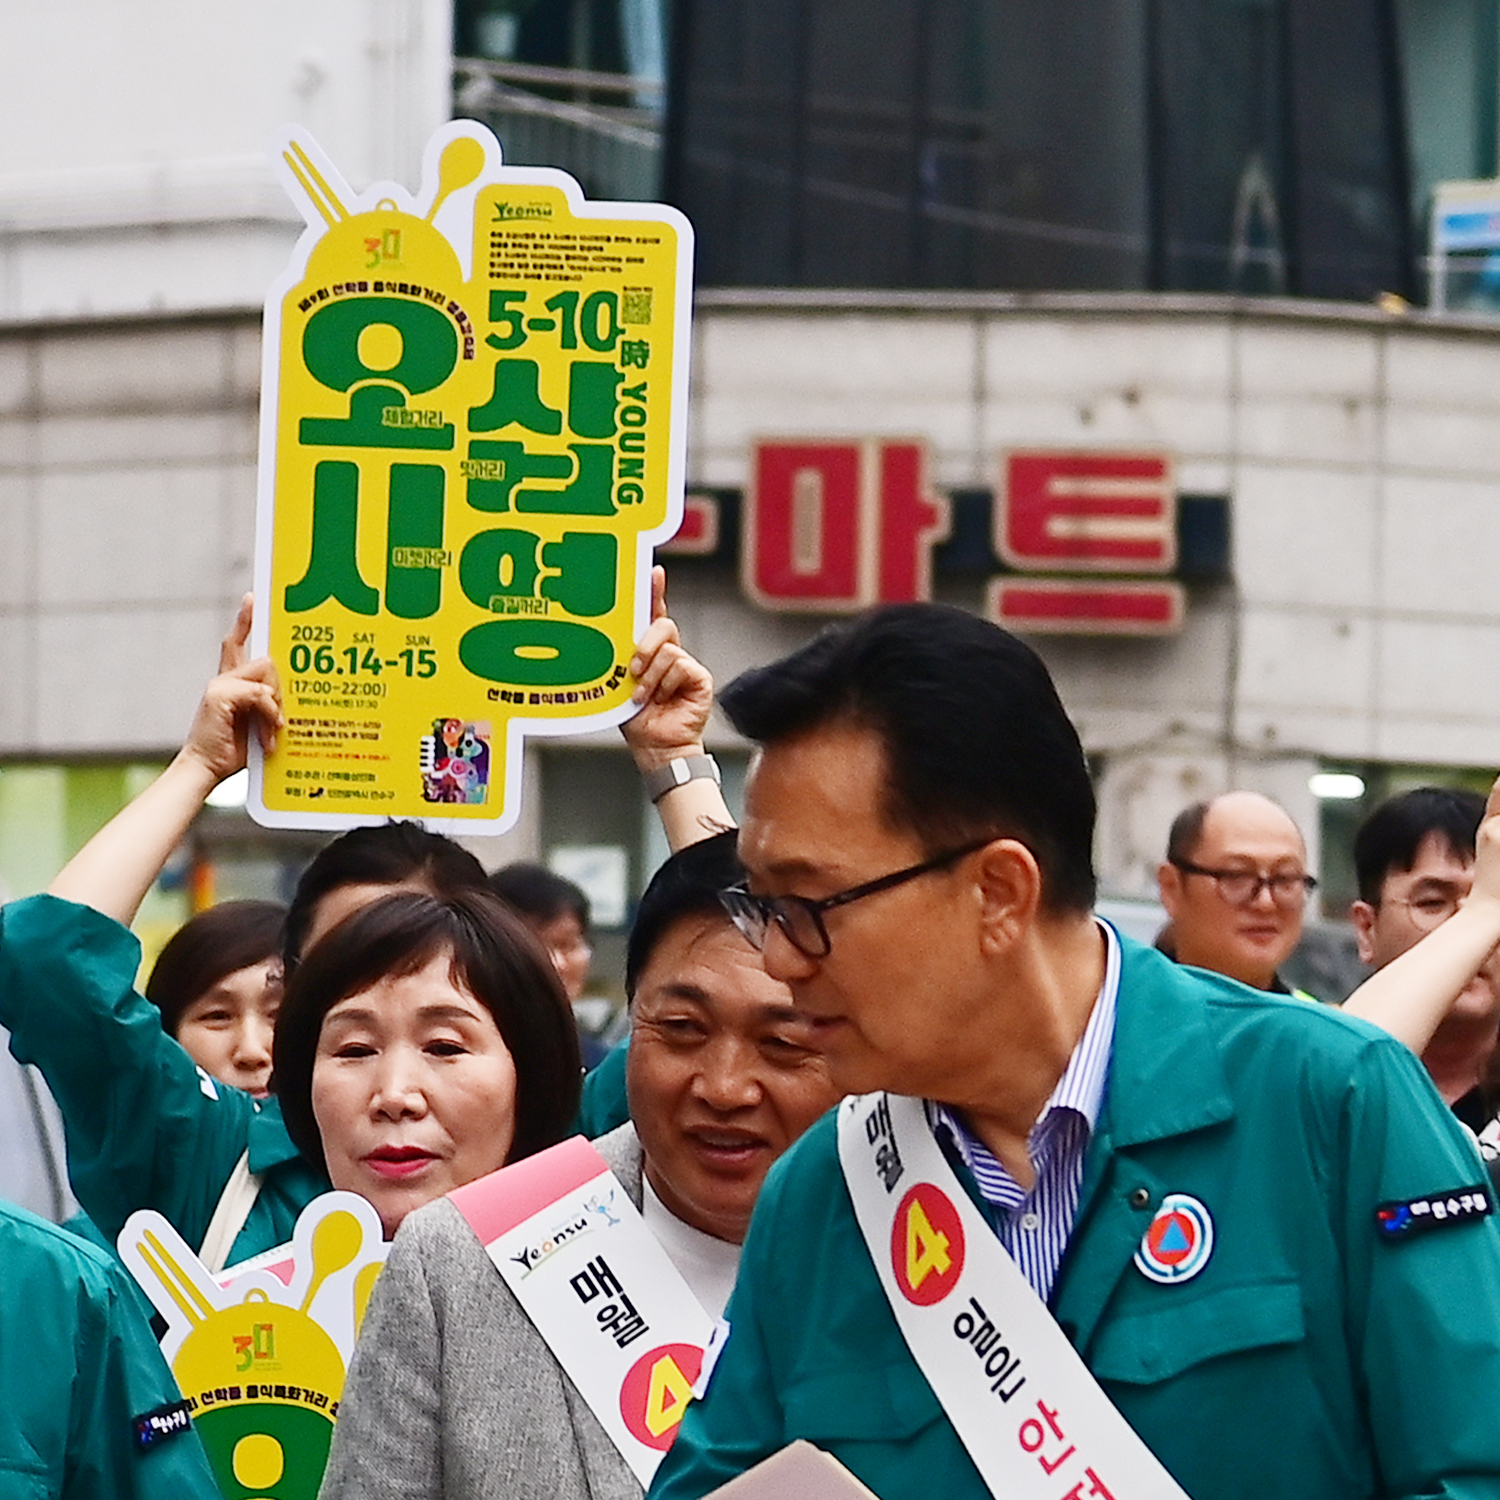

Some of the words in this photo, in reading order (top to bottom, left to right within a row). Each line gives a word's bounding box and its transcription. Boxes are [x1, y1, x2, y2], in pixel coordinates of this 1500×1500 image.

[493, 201, 553, 222] Yeonsu
[485, 289, 625, 353] 5-10
[617, 380, 649, 506] YOUNG
[289, 643, 437, 678] 06.14-15
[291, 625, 334, 643] 2025
[353, 632, 375, 645] SAT
[405, 634, 431, 647] SUN
[509, 1216, 592, 1276] Yeonsu
[568, 1253, 651, 1350] 매월
[905, 1197, 952, 1292] 4
[952, 1296, 1028, 1405] 일은
